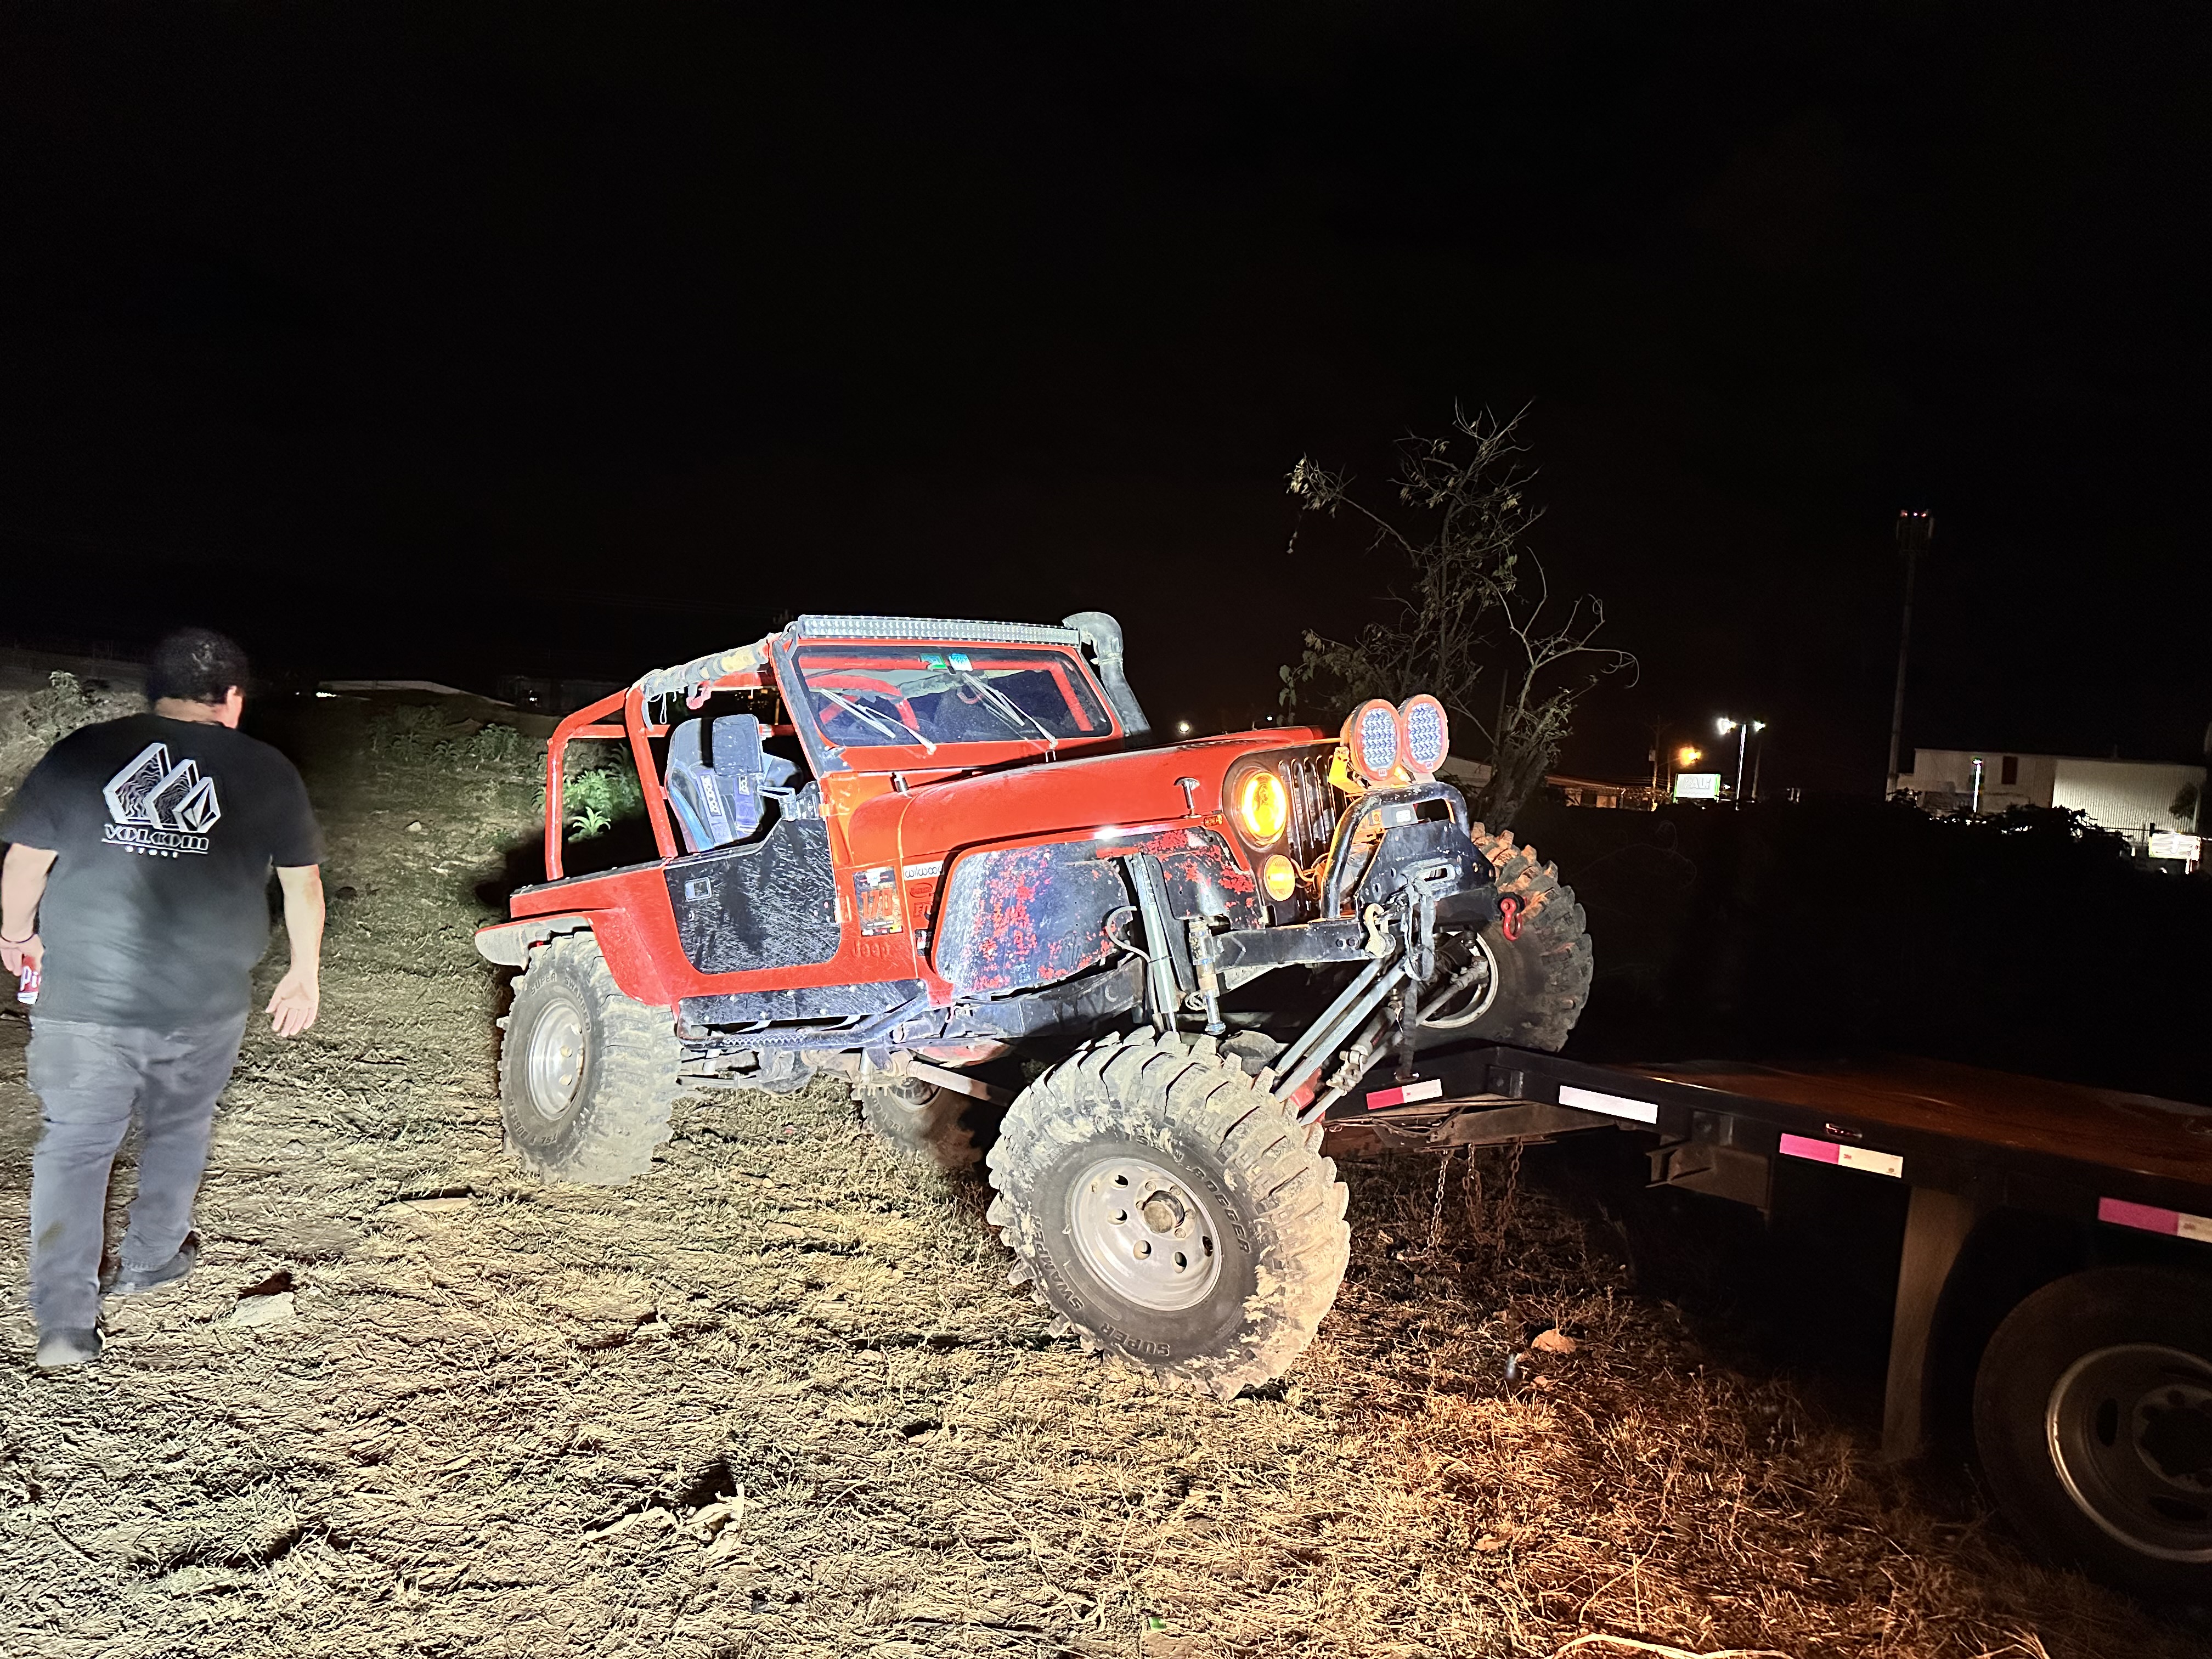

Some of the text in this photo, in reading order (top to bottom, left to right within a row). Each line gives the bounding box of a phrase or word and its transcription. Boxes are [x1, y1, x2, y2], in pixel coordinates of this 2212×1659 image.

[104, 823, 209, 850] VOLCOM
[861, 887, 893, 920] 170
[850, 940, 890, 959] Jeep
[531, 972, 557, 996] SUPER
[1192, 1166, 1251, 1254] BOGGER
[1031, 1215, 1085, 1310] SWAMPER
[1100, 1322, 1170, 1357] SUPER
